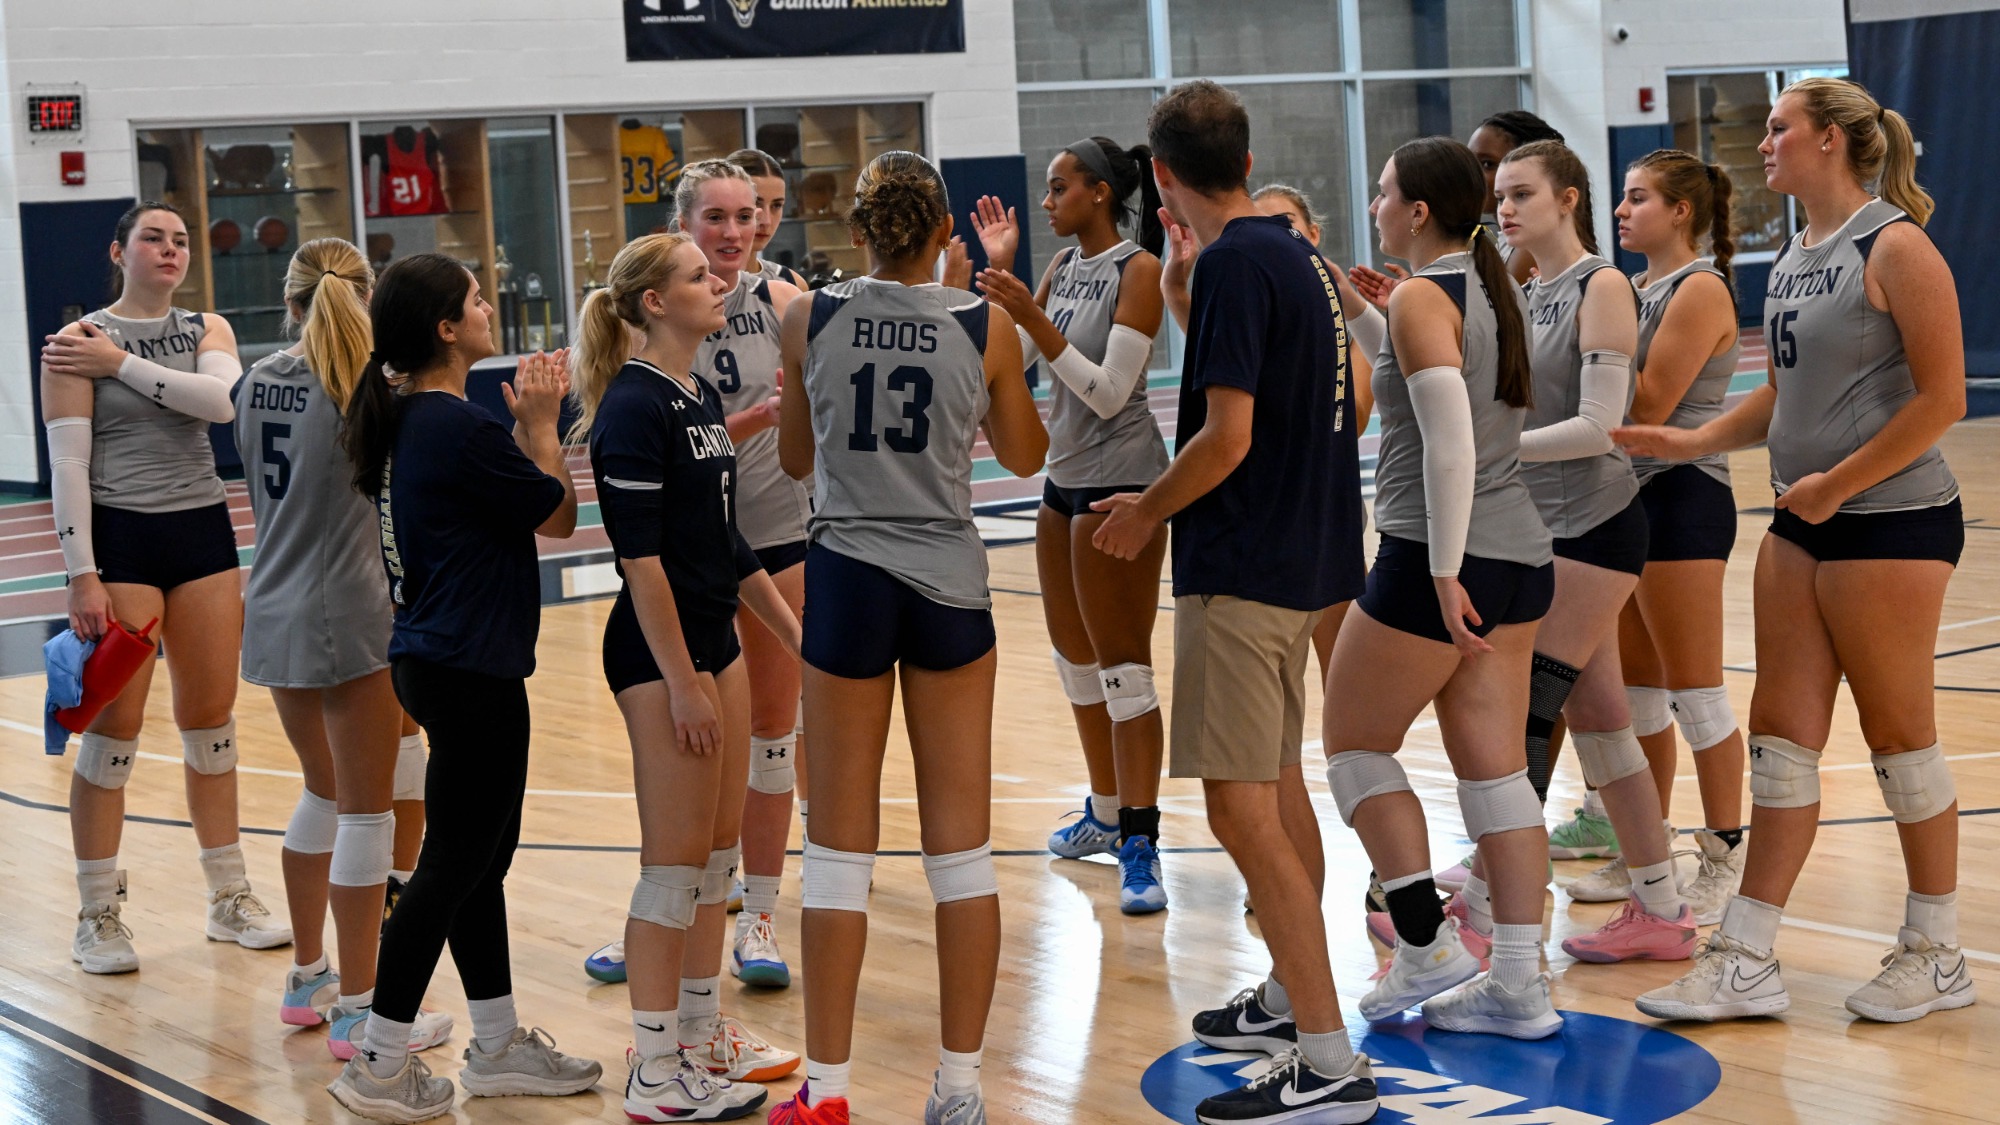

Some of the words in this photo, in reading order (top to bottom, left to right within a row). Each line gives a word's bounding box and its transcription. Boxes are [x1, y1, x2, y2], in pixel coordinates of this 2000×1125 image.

[641, 16, 669, 24] UNDER
[670, 15, 706, 23] ARMOUR
[41, 101, 75, 128] EXIT
[392, 174, 421, 205] 21
[621, 156, 655, 194] 33
[123, 330, 198, 359] ANTON
[852, 317, 938, 354] ROOS
[1309, 255, 1347, 402] KANGAROOS
[1770, 310, 1799, 369] 15
[714, 348, 742, 394] 9
[250, 382, 310, 413] ROOS
[848, 362, 934, 453] 13
[686, 423, 736, 459] CANTO
[261, 421, 292, 500] 5
